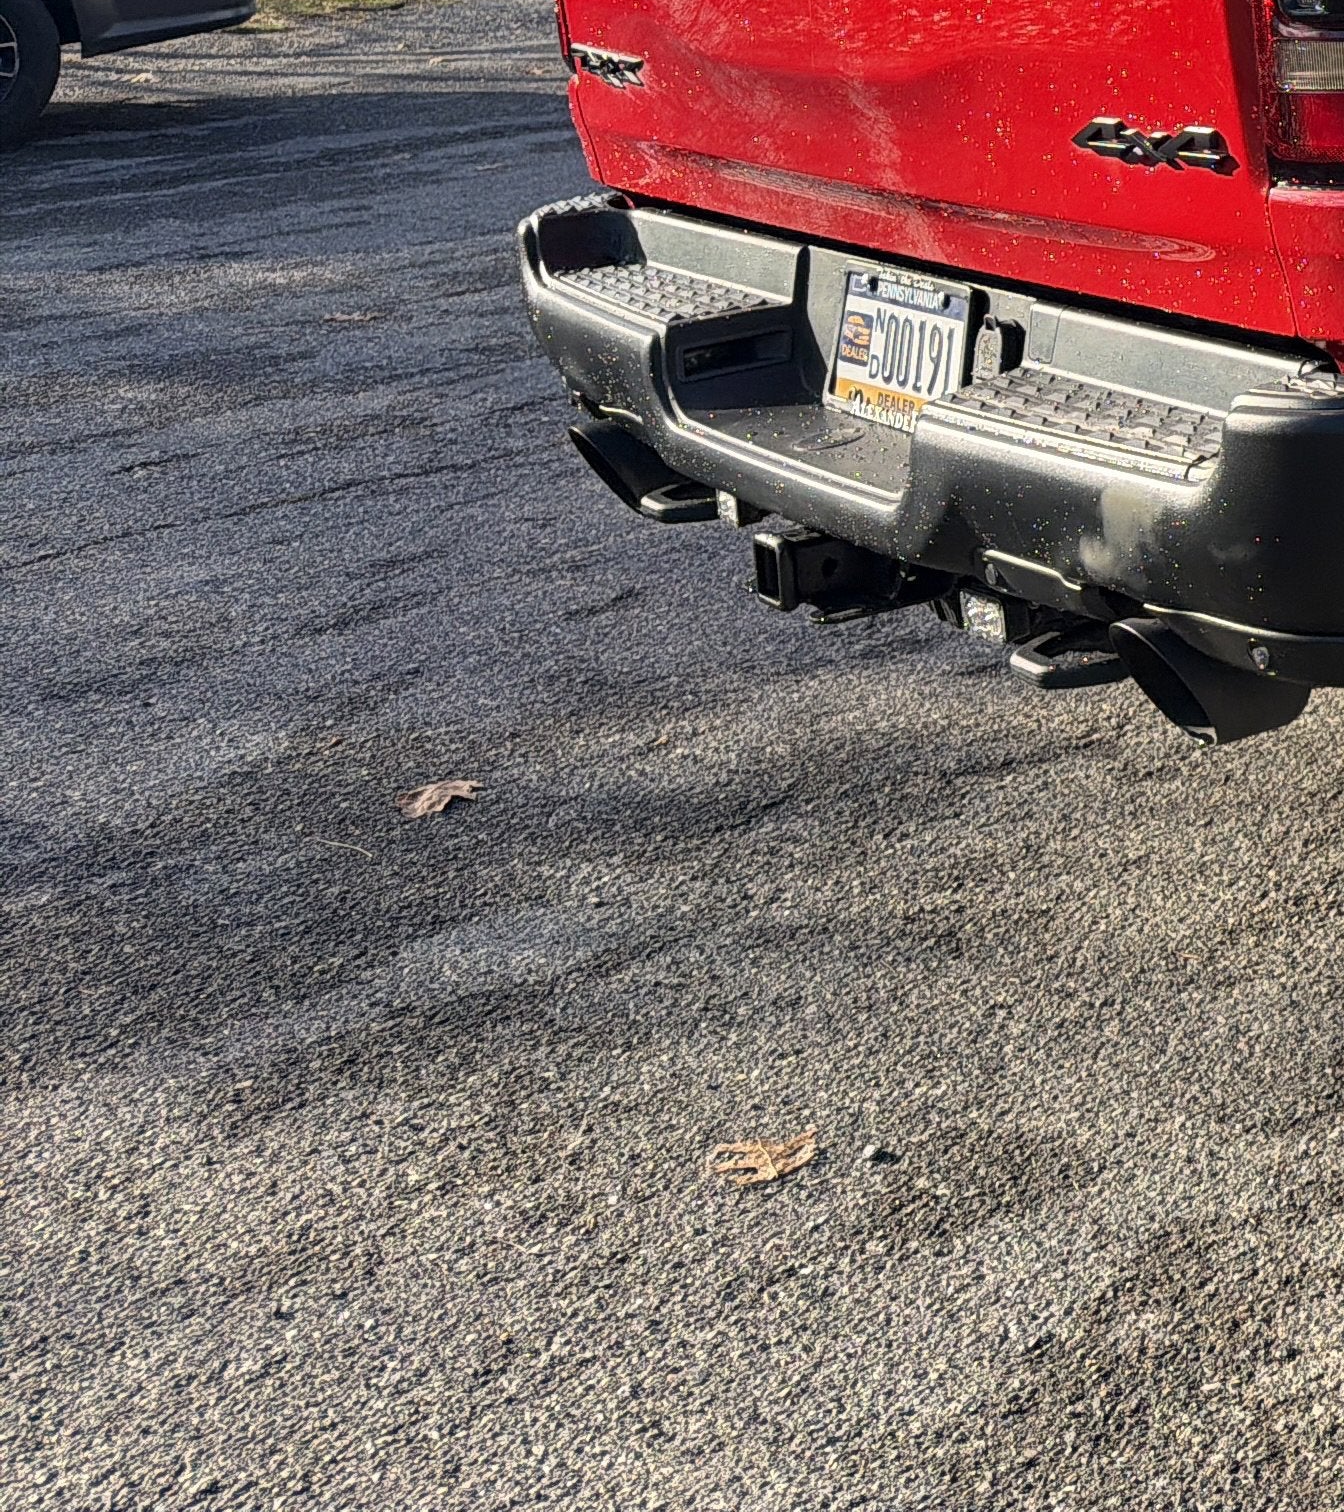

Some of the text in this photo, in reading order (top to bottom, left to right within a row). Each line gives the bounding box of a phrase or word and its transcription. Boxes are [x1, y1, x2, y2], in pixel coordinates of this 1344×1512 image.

[877, 281, 938, 309] PENNSYLVANIA
[841, 343, 869, 362] DEALER
[877, 391, 916, 415] DEALER
